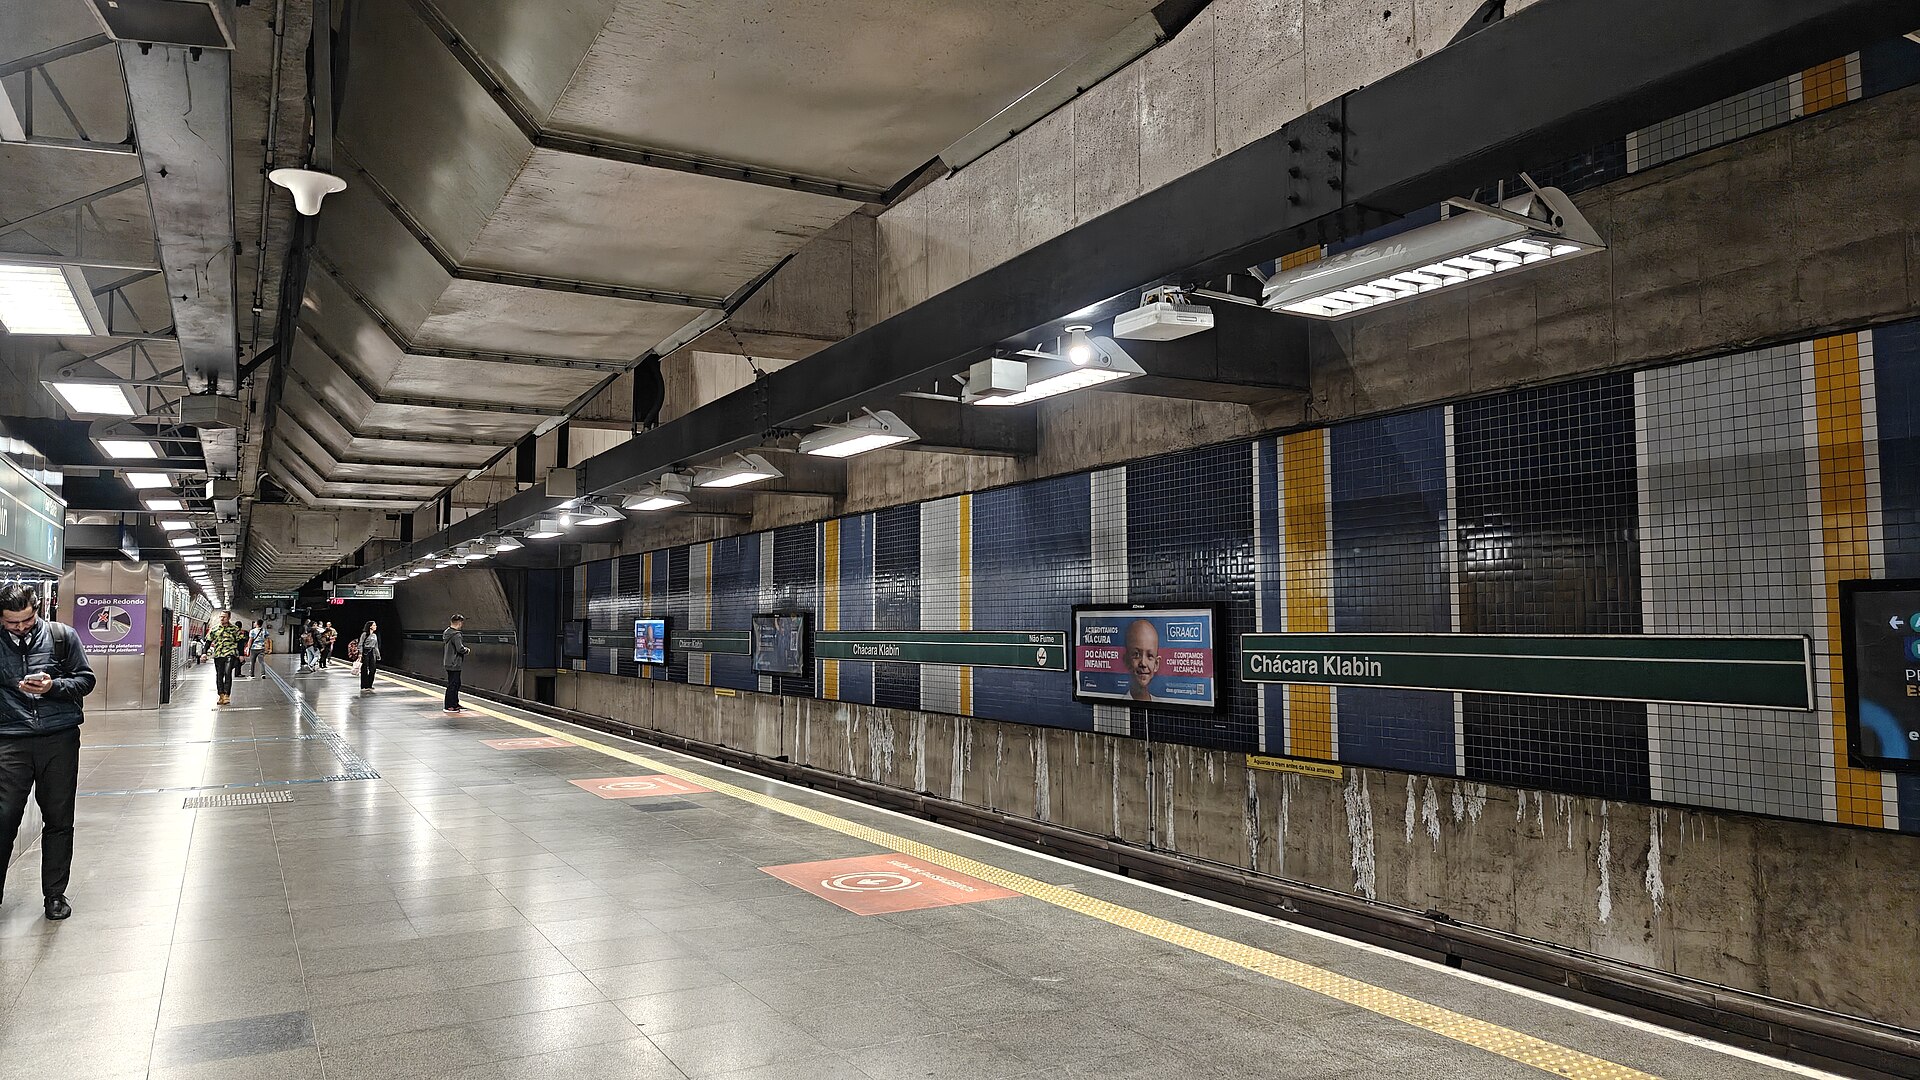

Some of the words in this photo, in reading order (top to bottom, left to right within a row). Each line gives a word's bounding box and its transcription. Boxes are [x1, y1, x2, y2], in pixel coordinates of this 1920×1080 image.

[1169, 626, 1199, 638] GRAACC
[1085, 635, 1093, 643] NA
[1094, 635, 1111, 644] CURA
[853, 643, 877, 655] Chácara
[879, 644, 899, 656] Klabin
[1085, 650, 1094, 658] DO
[1095, 649, 1119, 659] CÂNCER
[1085, 660, 1111, 669] INFANTIL
[1250, 654, 1318, 675] Chácara
[1323, 656, 1382, 677] Klabin
[1907, 685, 1920, 697] E
